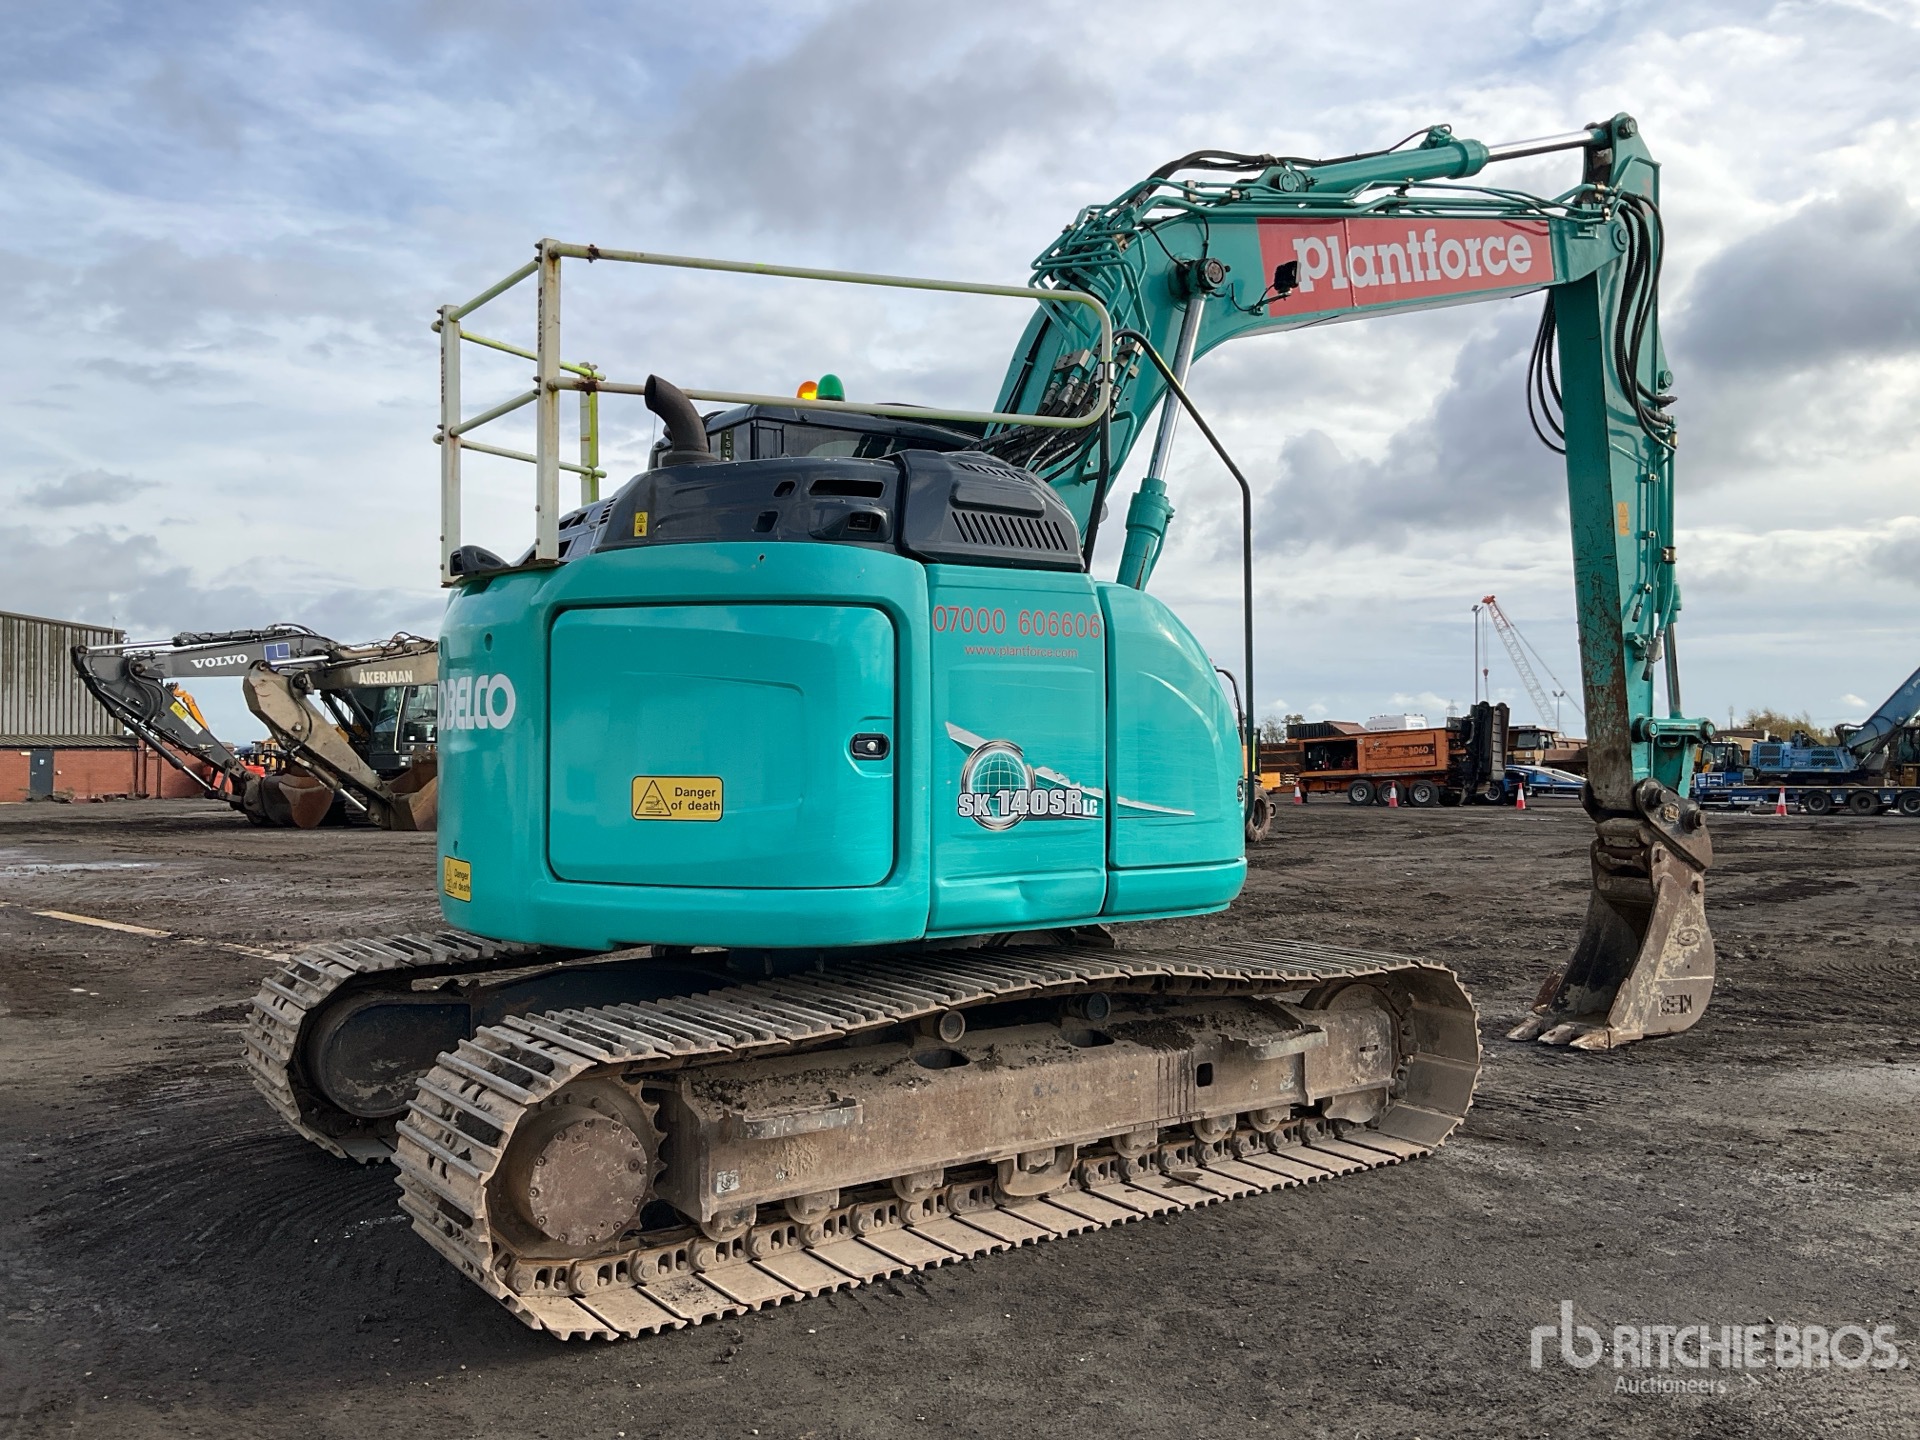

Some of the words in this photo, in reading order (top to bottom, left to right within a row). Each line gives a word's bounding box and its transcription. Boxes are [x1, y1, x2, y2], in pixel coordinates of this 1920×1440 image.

[1292, 228, 1532, 293] plantforce
[932, 605, 1006, 634] 07000
[1018, 609, 1100, 639] 606606
[964, 645, 1078, 658] www.plantforce.com
[191, 653, 248, 669] VOLVO
[358, 669, 413, 685] ÅKERMAN
[438, 673, 516, 731] OBELCO
[674, 787, 717, 800] Danger
[670, 801, 682, 811] of
[687, 801, 721, 811] death
